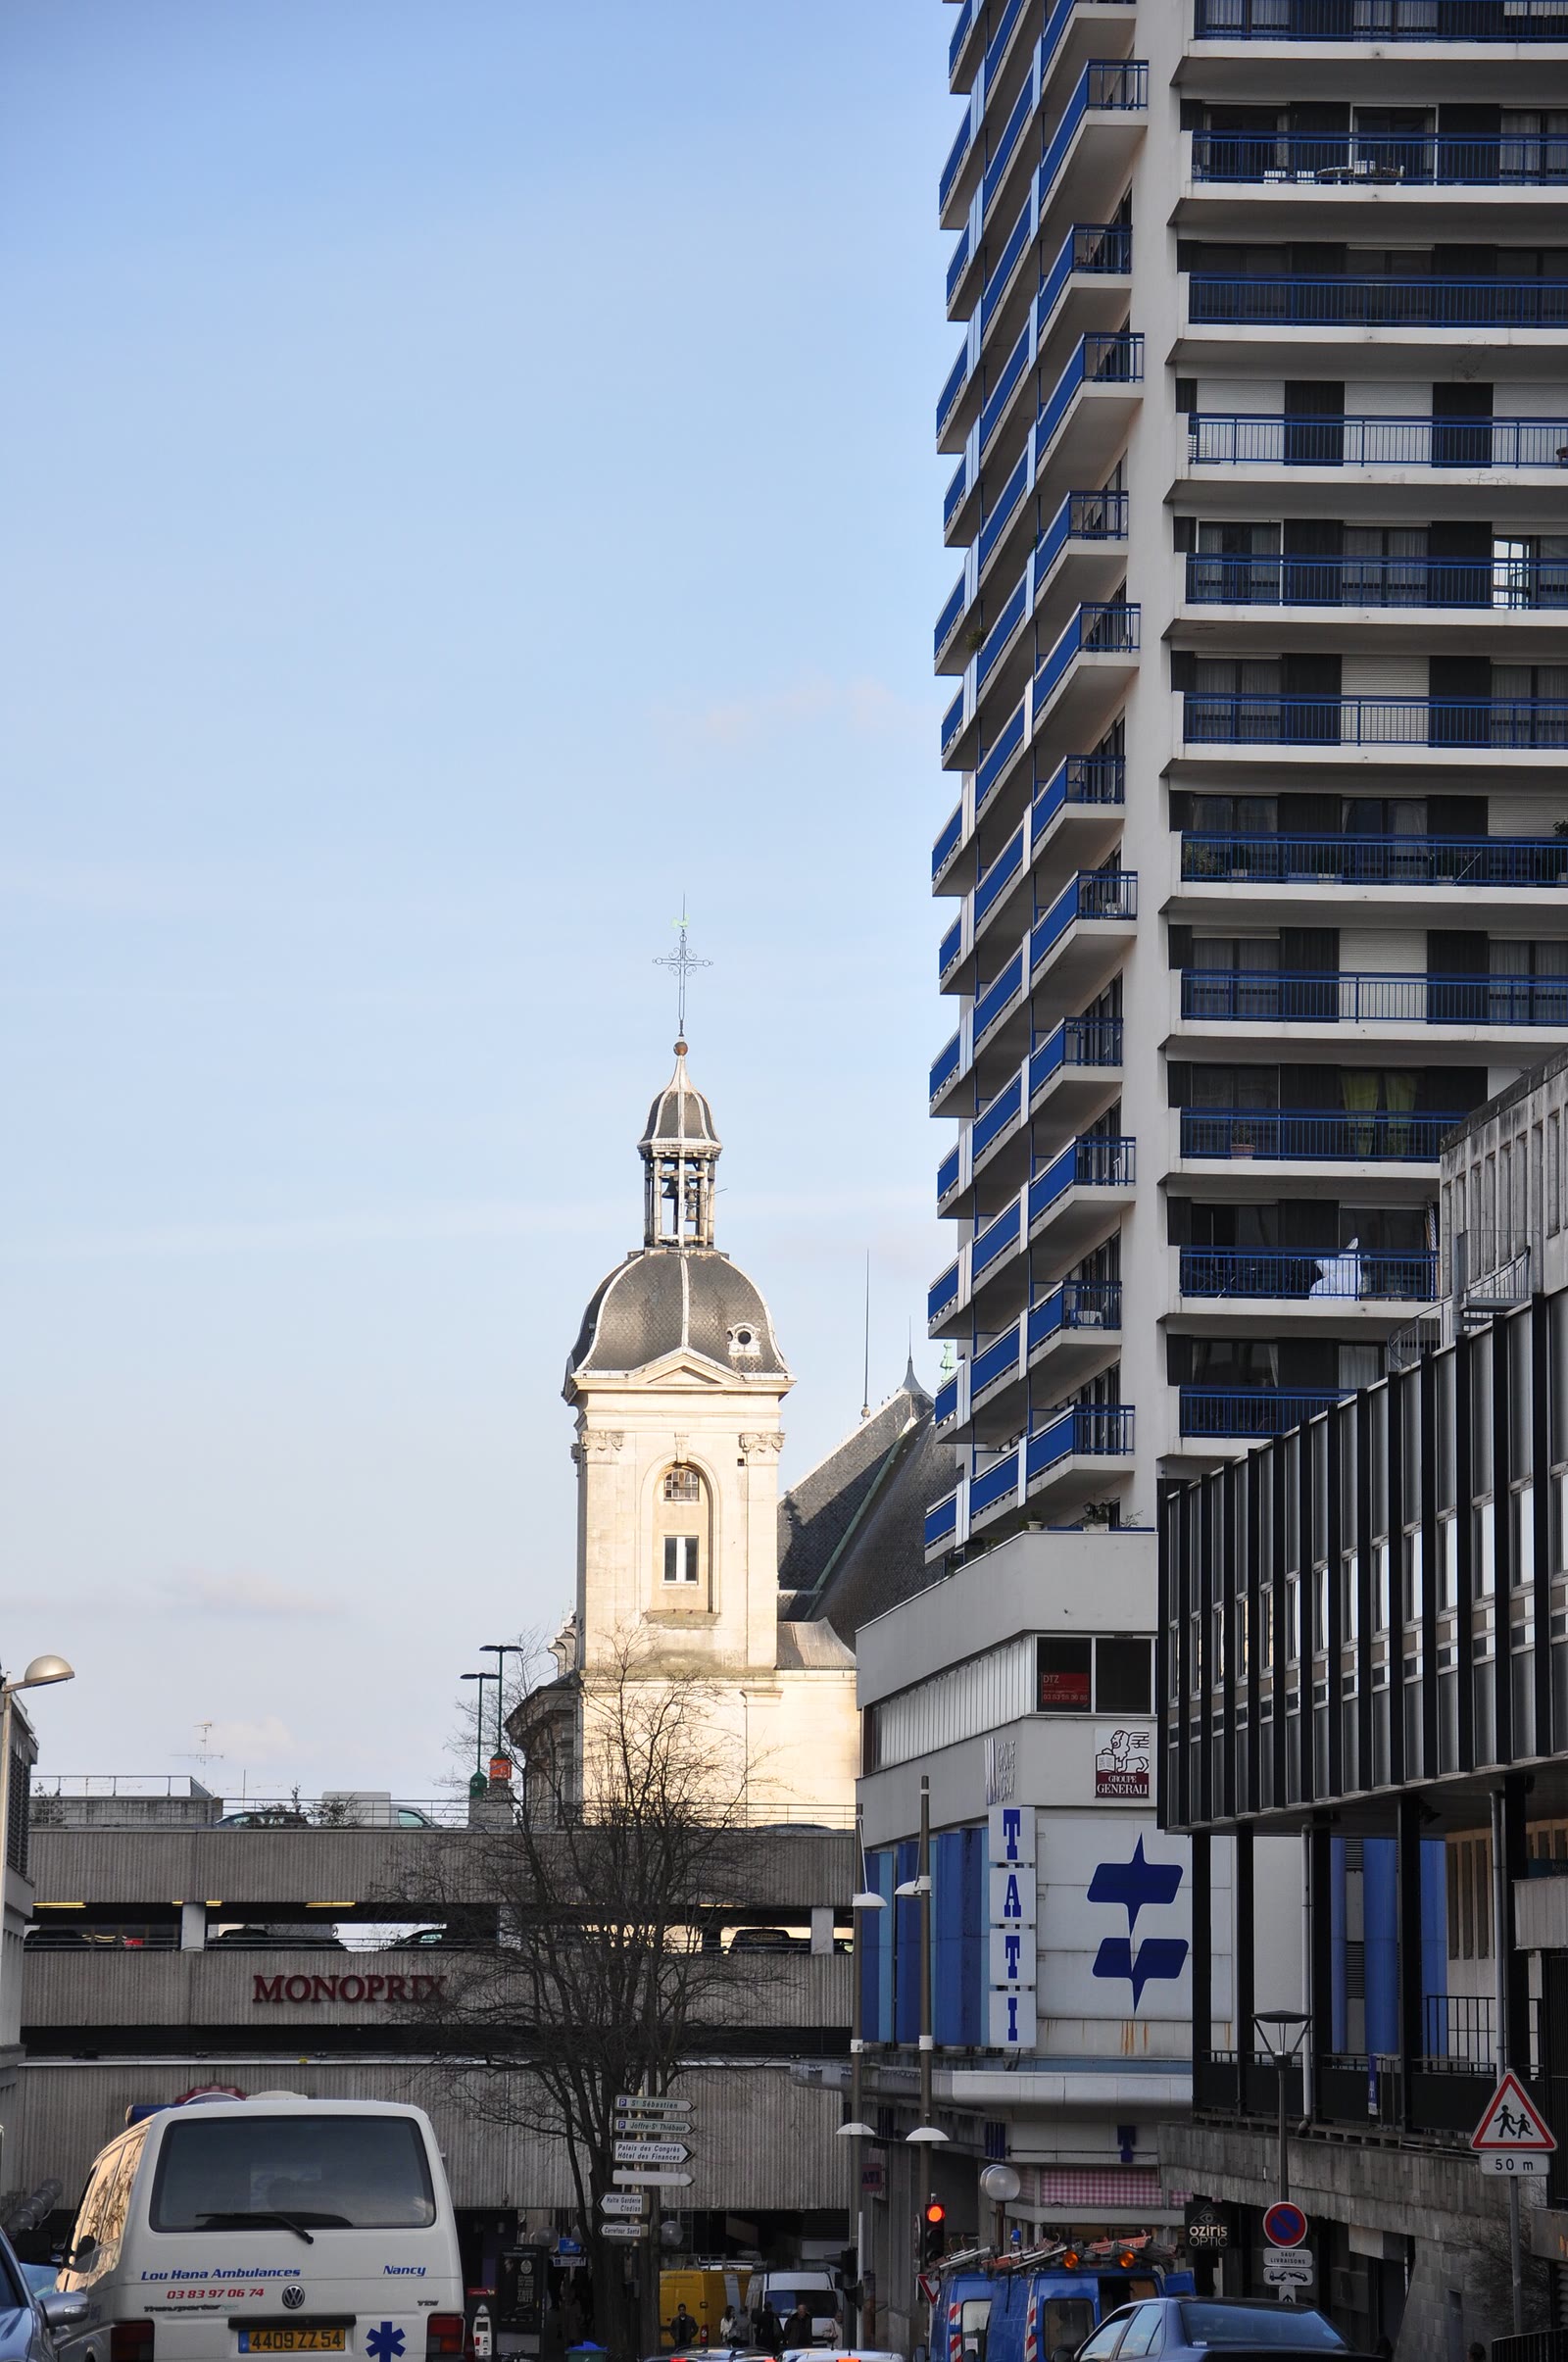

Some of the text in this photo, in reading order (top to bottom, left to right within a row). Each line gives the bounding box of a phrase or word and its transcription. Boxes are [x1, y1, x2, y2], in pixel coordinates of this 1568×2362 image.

[1108, 1775, 1137, 1784] GROUPE
[1097, 1784, 1148, 1795] GENERALI
[253, 1974, 447, 2003] MONOPRIX
[643, 2100, 678, 2109] Sébastien
[654, 2145, 680, 2154] Congrès
[1495, 2158, 1534, 2171] 50 m
[1189, 2225, 1228, 2237] oziris
[1189, 2236, 1228, 2247] OPTIC
[141, 2267, 301, 2281] Lou Hana Ambulances
[383, 2265, 426, 2277] Nancy
[167, 2288, 265, 2299] 03 83 97 06 74
[252, 2331, 341, 2349] 4409 ZZ 54
